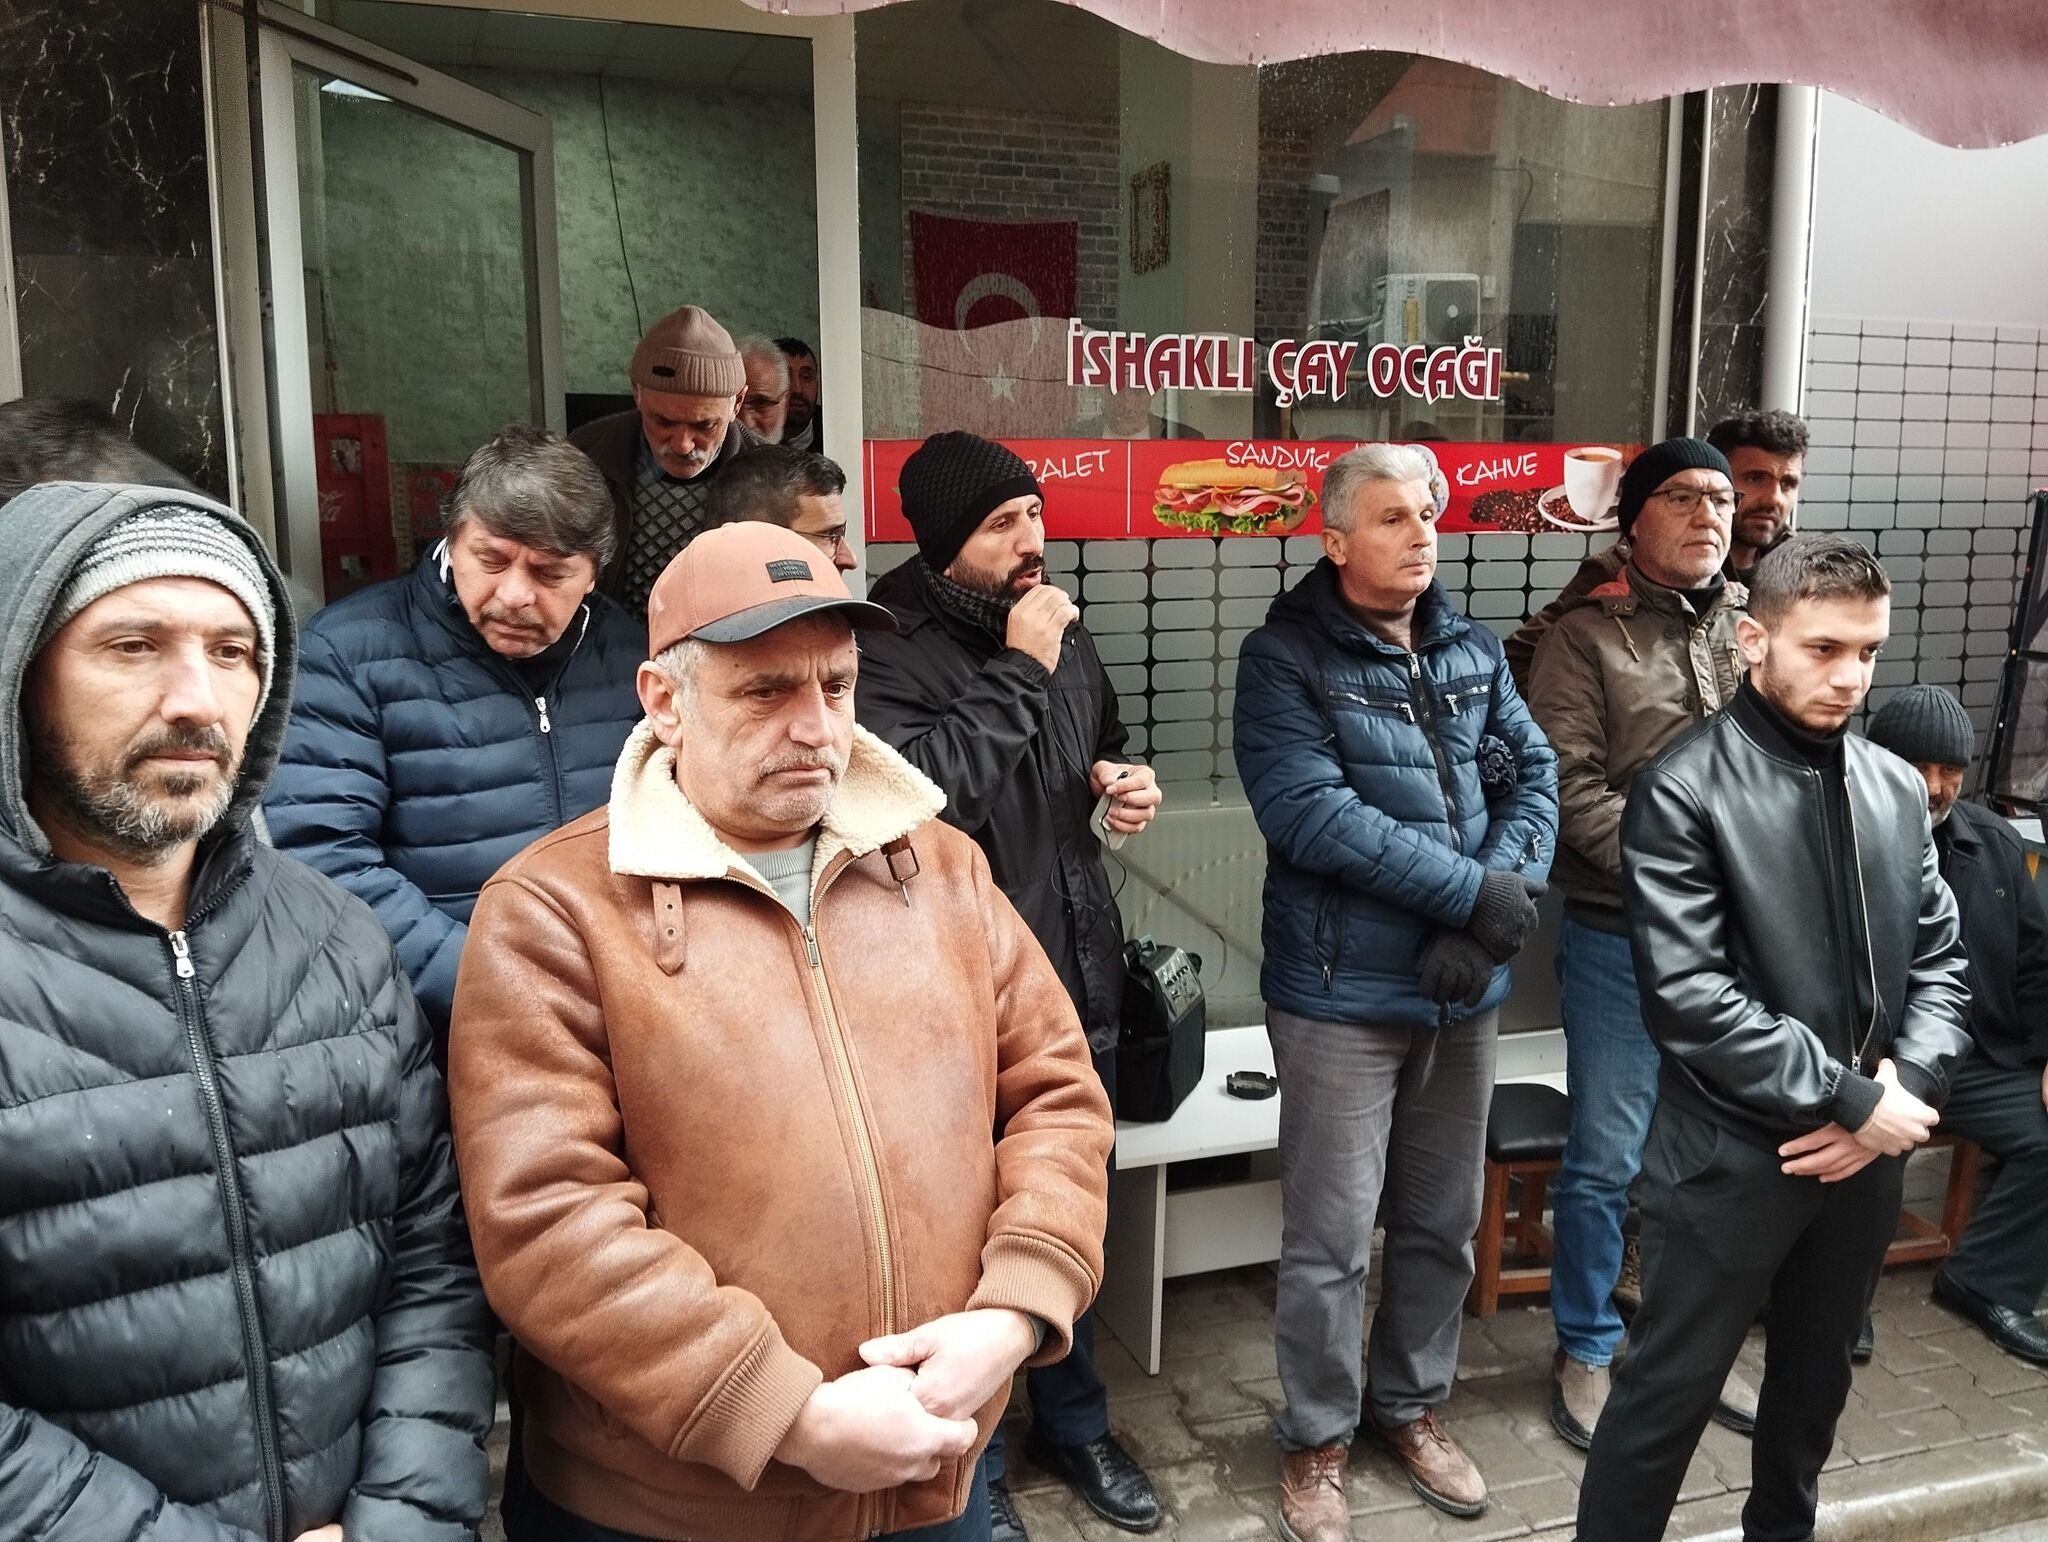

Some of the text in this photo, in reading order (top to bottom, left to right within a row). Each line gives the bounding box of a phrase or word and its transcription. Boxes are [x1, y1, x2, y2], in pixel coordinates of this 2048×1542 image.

[1067, 317, 1503, 408] İSHAKLI ÇAY OCAĞI
[1456, 452, 1537, 486] KAHVE
